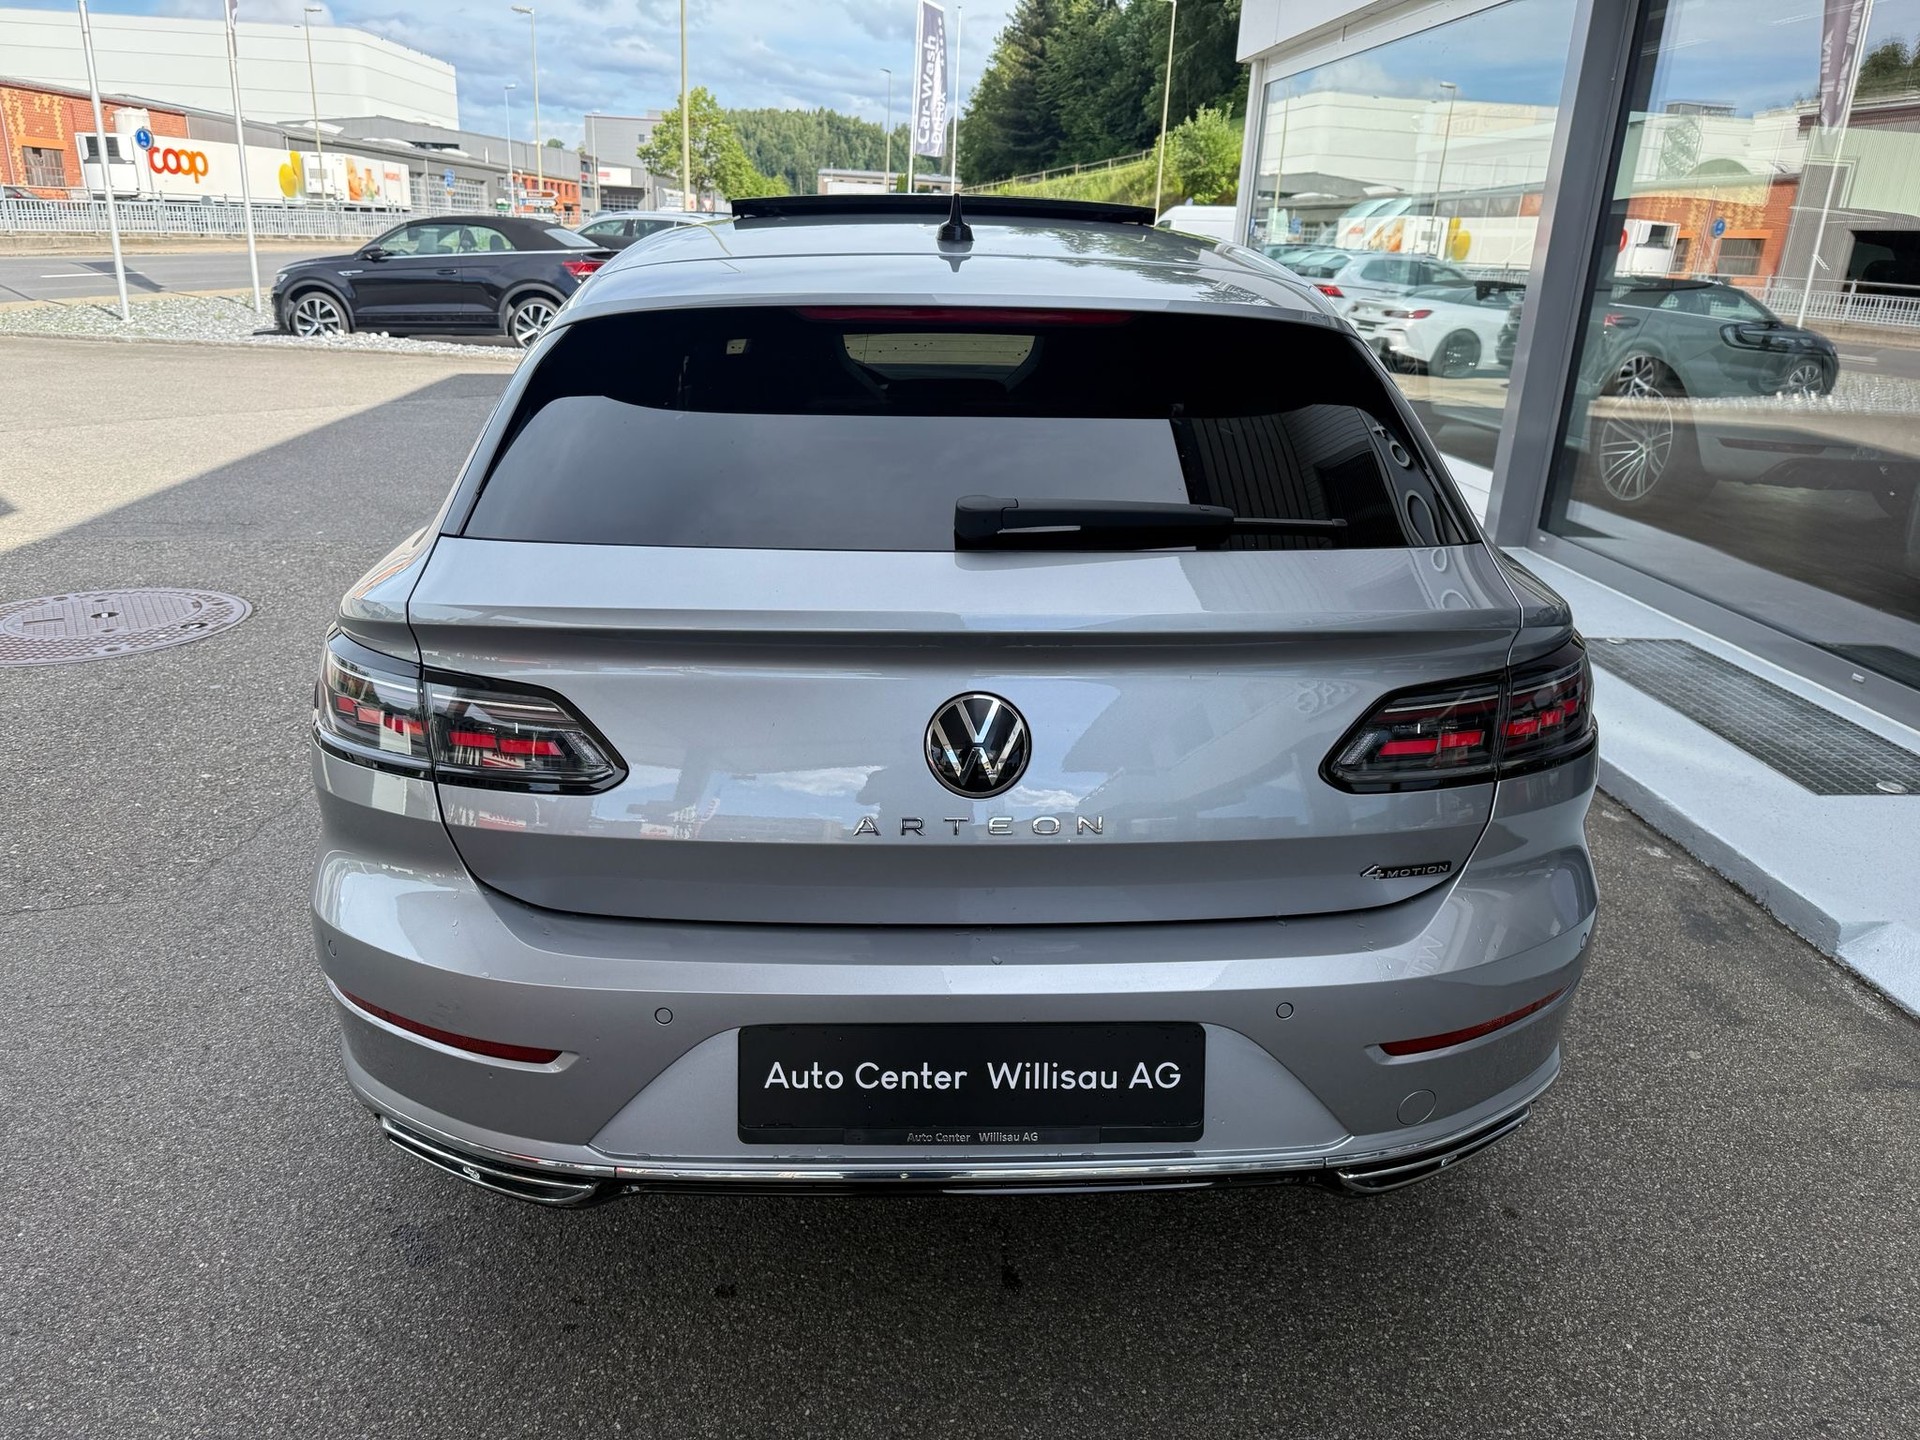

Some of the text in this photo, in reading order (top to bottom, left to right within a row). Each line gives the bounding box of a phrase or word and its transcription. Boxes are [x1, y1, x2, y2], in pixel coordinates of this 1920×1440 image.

[917, 35, 937, 145] Car-Wash
[148, 146, 208, 184] coop
[853, 816, 1104, 836] ARTEON
[1361, 864, 1449, 880] 4MOTION
[764, 1061, 1182, 1090] Auto Center Willisau AG
[906, 1131, 1039, 1142] Auto Center Willisau AG
